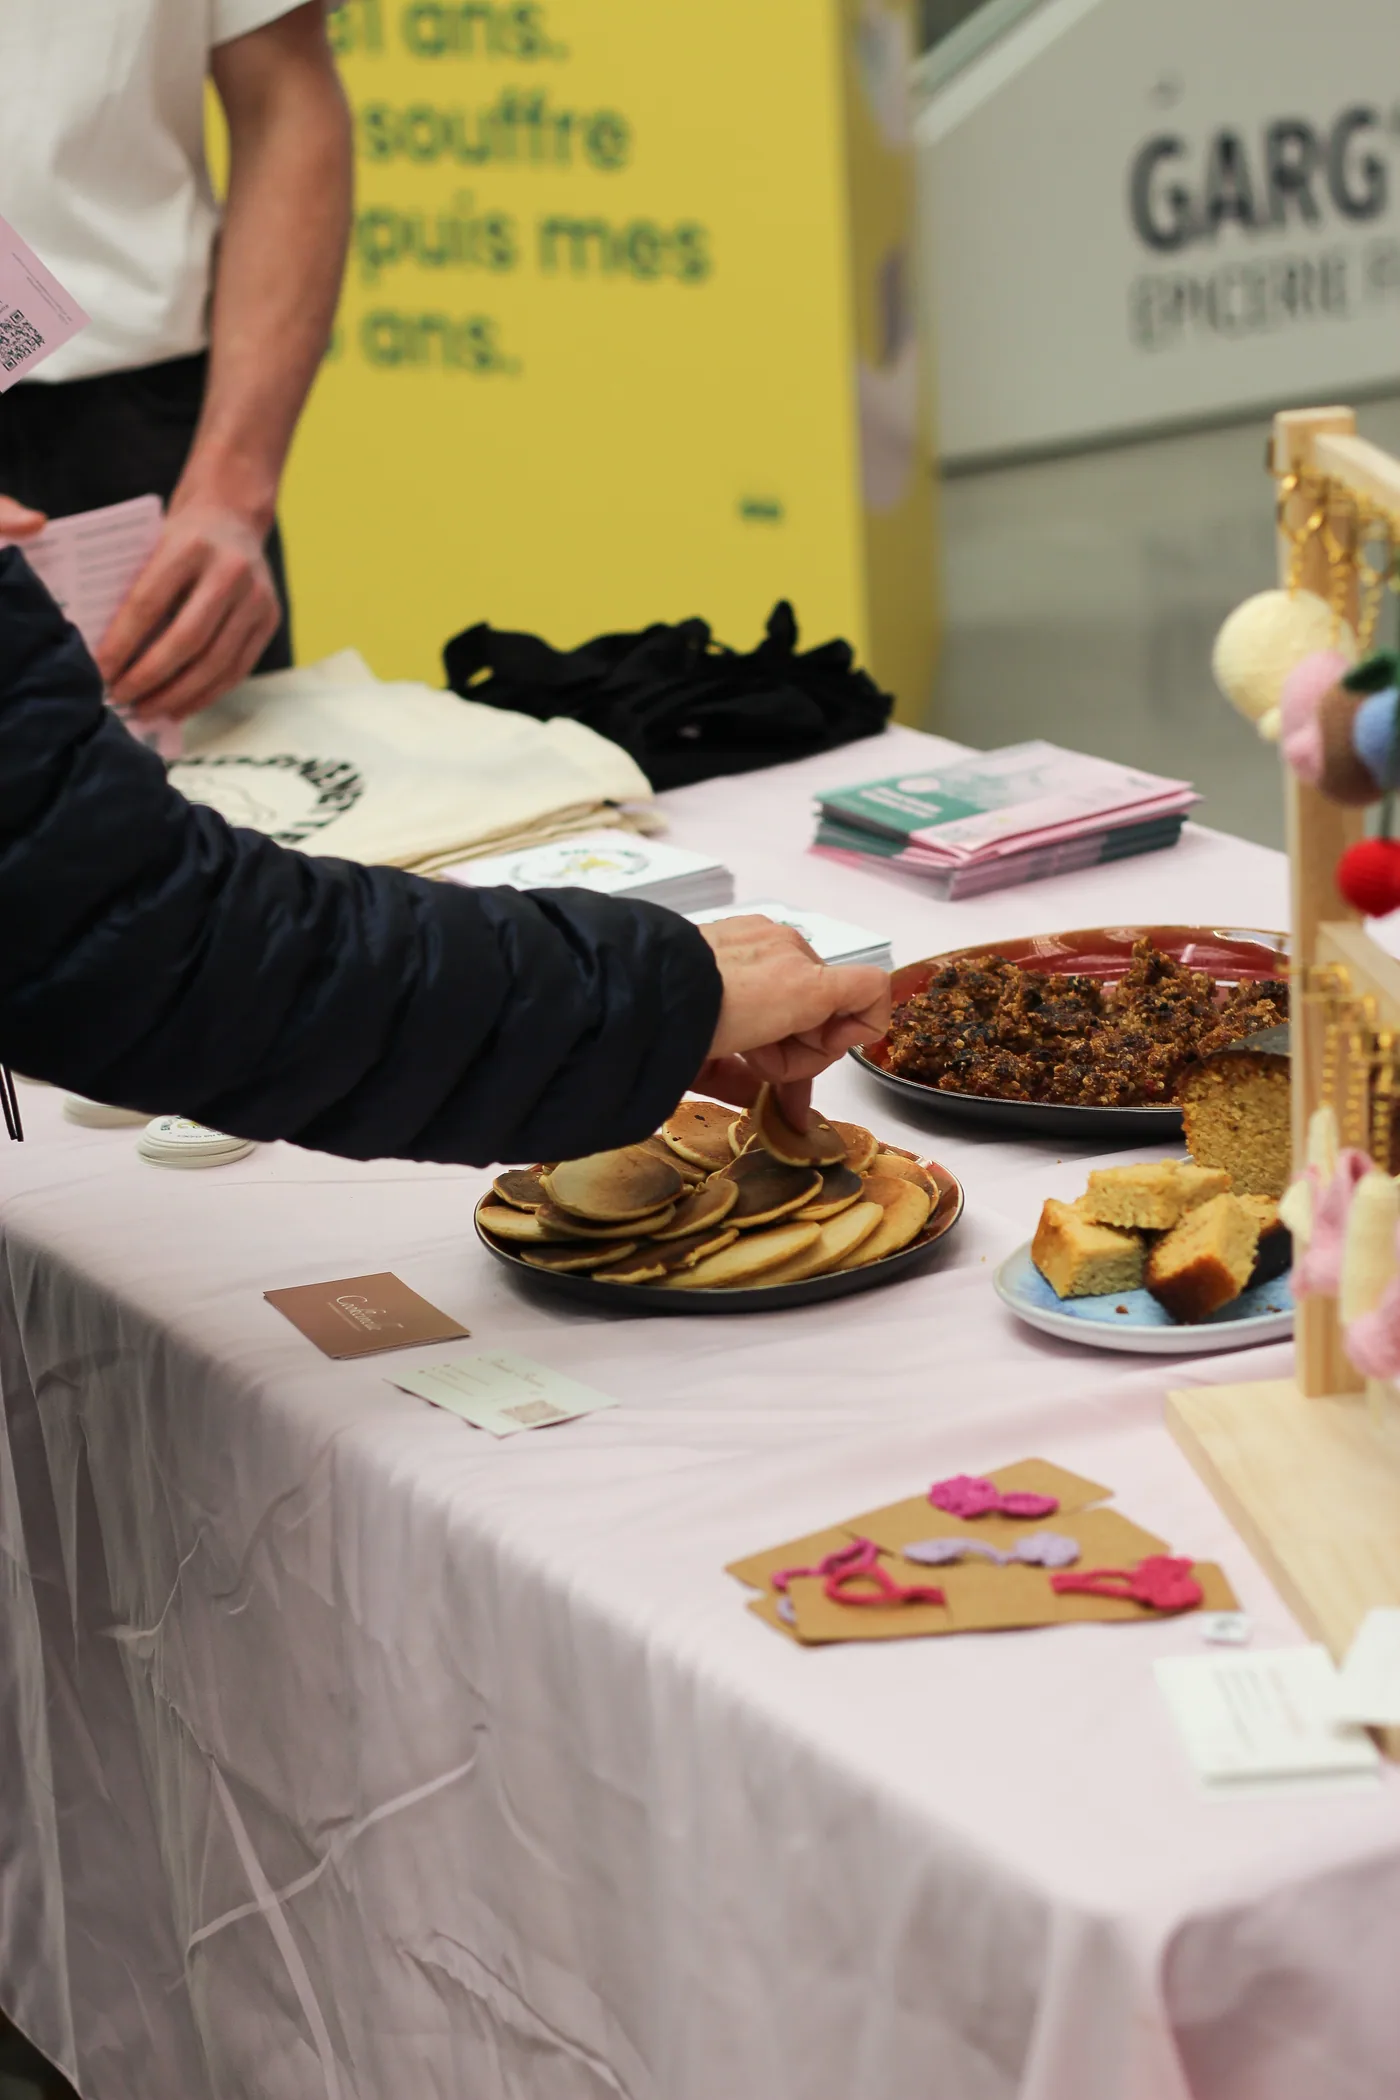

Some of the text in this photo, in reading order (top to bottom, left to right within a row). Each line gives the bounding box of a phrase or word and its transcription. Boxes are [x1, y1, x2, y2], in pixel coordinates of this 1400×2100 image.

[402, 2, 568, 62] ans.
[364, 89, 630, 168] souffre
[1128, 100, 1400, 252] GARG
[539, 211, 712, 283] mes
[360, 308, 522, 376] ans.
